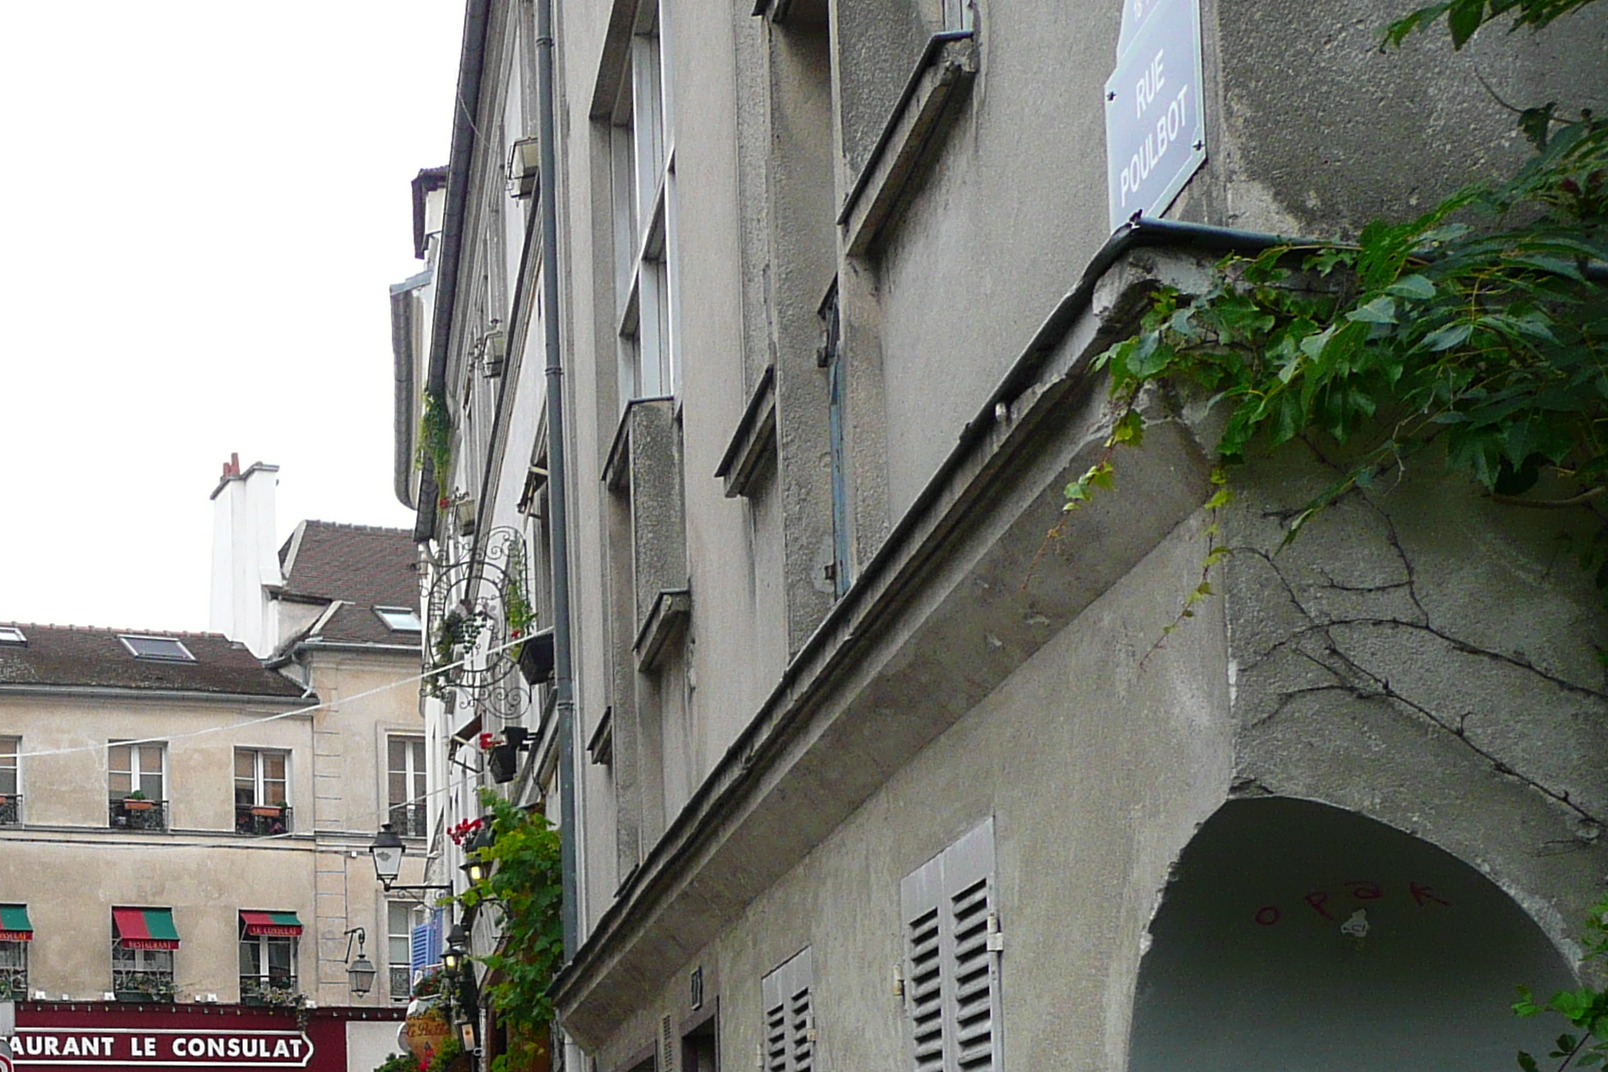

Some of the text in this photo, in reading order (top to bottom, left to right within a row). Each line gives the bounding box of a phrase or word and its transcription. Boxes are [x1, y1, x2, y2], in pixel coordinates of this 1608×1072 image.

[1135, 48, 1166, 119] RUE
[1120, 84, 1188, 208] POULBOT
[130, 1037, 157, 1057] LE
[172, 1038, 303, 1058] CONSULAT
